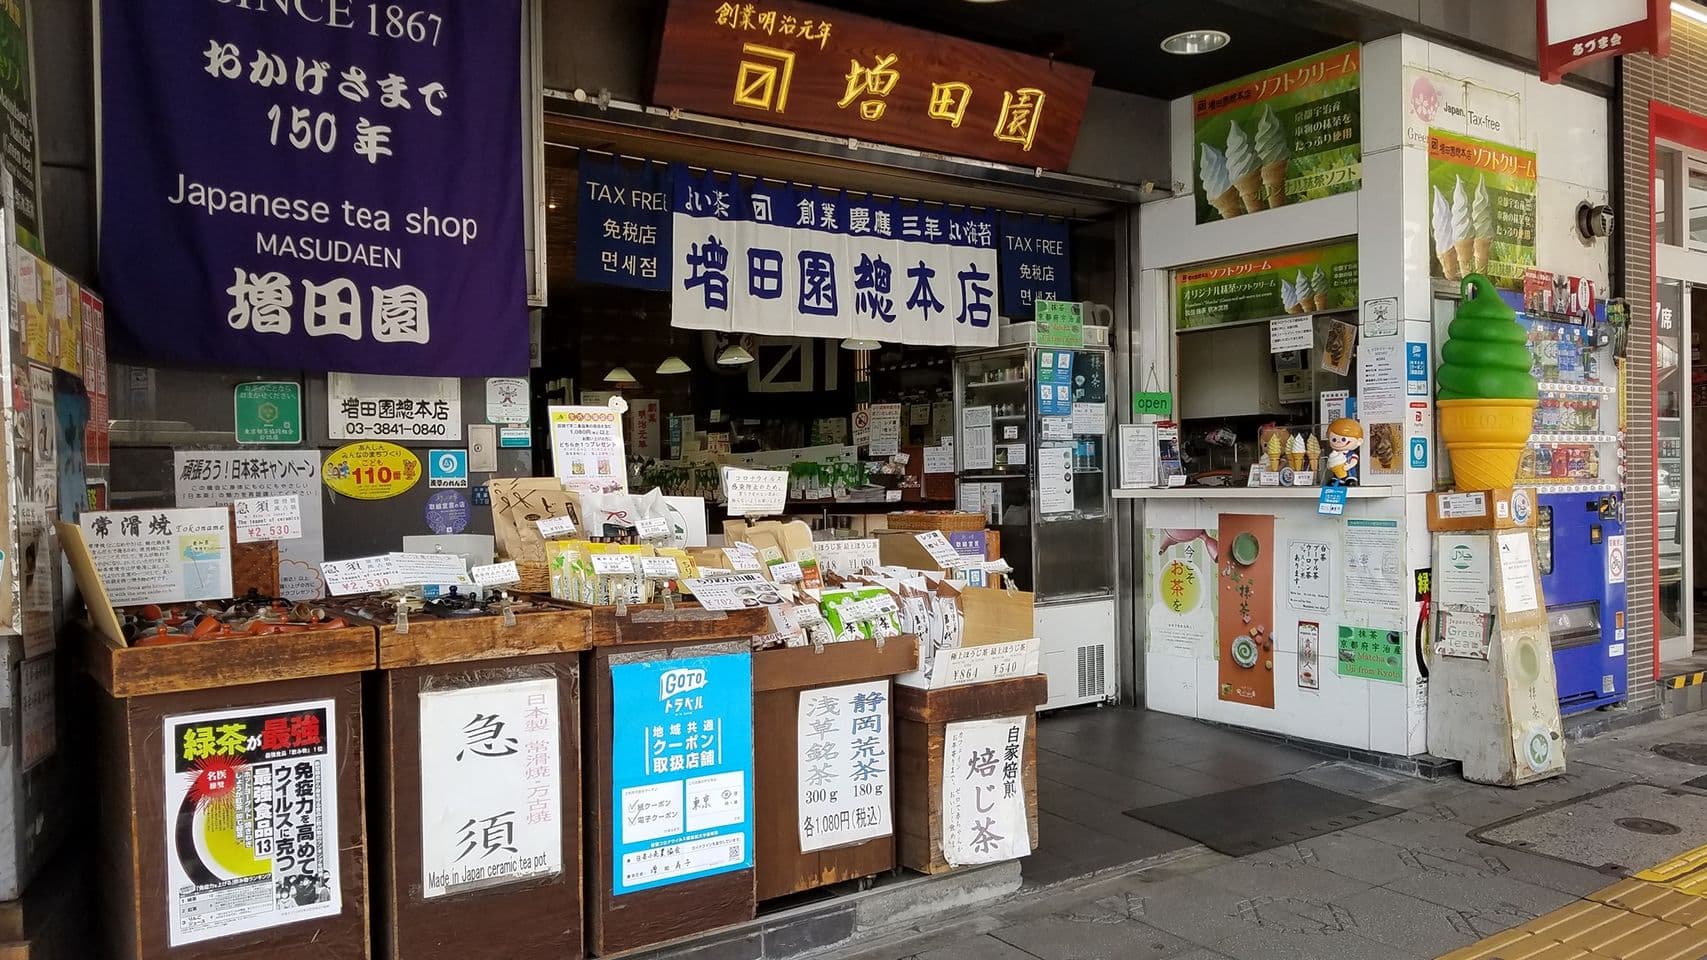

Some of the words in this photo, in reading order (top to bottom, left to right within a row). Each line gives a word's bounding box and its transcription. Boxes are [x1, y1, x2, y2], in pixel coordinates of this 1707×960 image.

[368, 3, 442, 47] 1867
[715, 2, 833, 50] 創業明治元年
[1572, 33, 1622, 56] あづま会
[204, 39, 448, 116] おかげさまで
[1255, 53, 1357, 100] ソフトクリーム
[837, 53, 1046, 151] 増田園
[1468, 111, 1501, 132] Tax-free
[1295, 128, 1352, 152] たっぷり使用
[1473, 148, 1536, 179] ソフトクリーム
[586, 181, 628, 207] TAX
[684, 185, 731, 218] よい茶
[168, 173, 329, 224] Japanese
[342, 200, 391, 232] tea
[405, 207, 477, 244] shop
[603, 218, 657, 245] 免税店
[949, 219, 992, 250] よい海苔
[256, 232, 402, 270] MASUDAEN
[1006, 235, 1033, 252] TAX
[1036, 238, 1064, 256] FREE
[601, 251, 657, 279] 면세점
[1020, 263, 1055, 283] 免税店
[1210, 260, 1272, 278] ソフトクリーム
[226, 267, 430, 345] 増田園
[1138, 399, 1167, 412] open
[346, 422, 446, 436] 03-3841-0840
[237, 501, 270, 515] 急須
[91, 514, 173, 539] 常滑焼
[175, 524, 225, 533] Tokoname
[322, 560, 361, 575] 急須
[1184, 545, 1195, 585] 今こそ
[1239, 584, 1251, 618] 抹茶
[1358, 629, 1378, 639] 抹茶
[1448, 626, 1481, 638] Green
[1448, 638, 1470, 649] Tea
[1340, 639, 1401, 655] 京都府宇治産
[1358, 652, 1386, 664] Matcha
[1358, 665, 1376, 675] from
[1377, 666, 1401, 679] Kyoto
[524, 693, 550, 733] 日本製
[664, 696, 704, 714] トラベル
[182, 714, 321, 761] 緑茶が最強
[652, 719, 713, 738] 地域共通
[805, 695, 841, 787] 浅草銘茶
[849, 690, 886, 782] 静岡荒茶
[653, 735, 714, 755] クーポン
[207, 770, 227, 781] 名医
[653, 750, 716, 774] 取扱店舗
[1002, 726, 1020, 799] 自家焙煎
[453, 713, 519, 863] 急須
[525, 739, 551, 825] 常滑焼・万古焼
[692, 793, 712, 811] 東京
[966, 747, 1005, 855] 焙じ茶
[275, 765, 294, 872] ウイルスに克つ
[294, 762, 315, 874] 免疫力を高めて
[428, 870, 451, 890] Made
[452, 869, 460, 884] in
[461, 863, 486, 883] Japan
[487, 856, 518, 876] ceramic
[519, 853, 533, 870] tea
[534, 851, 547, 870] pot
